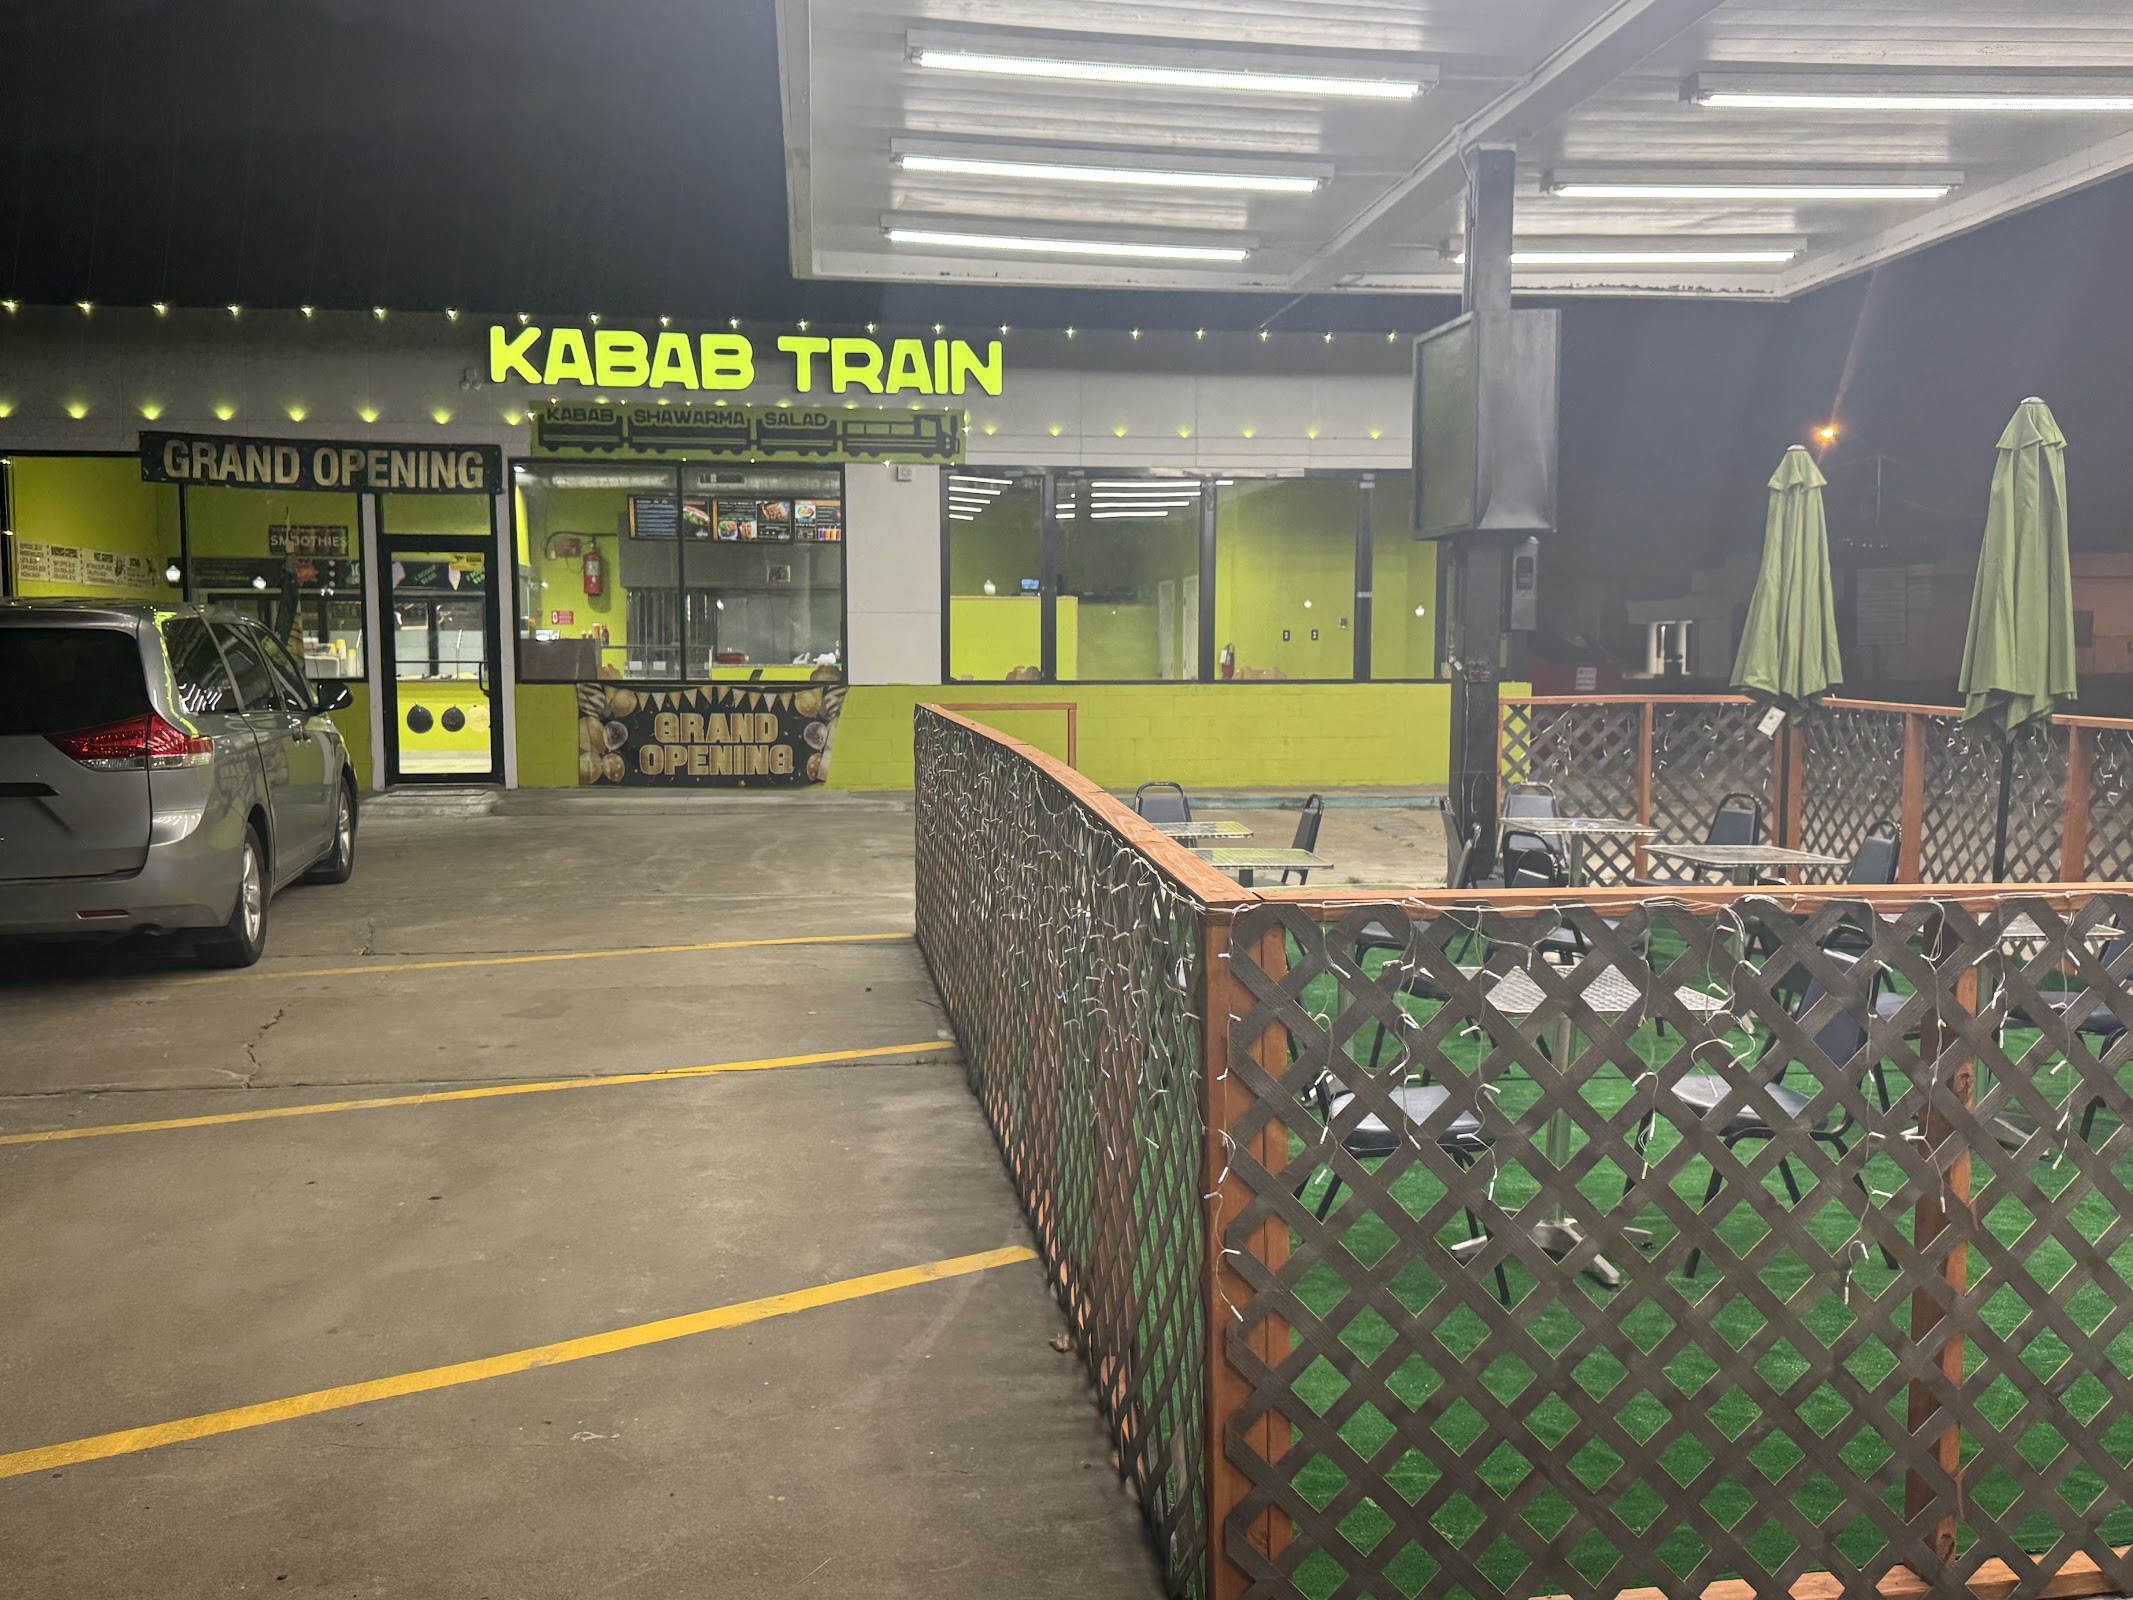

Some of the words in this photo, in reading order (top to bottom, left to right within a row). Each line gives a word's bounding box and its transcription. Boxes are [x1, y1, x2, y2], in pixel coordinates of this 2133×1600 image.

[490, 325, 755, 390] KABAB
[777, 335, 1002, 396] TRAIN
[547, 408, 615, 424] KABAB
[634, 409, 746, 426] SHAWARMA
[765, 412, 828, 427] SALAD
[163, 439, 301, 485] GRAND
[312, 447, 485, 489] OPENING
[654, 712, 779, 744] GRAND
[639, 744, 794, 776] OPENING
